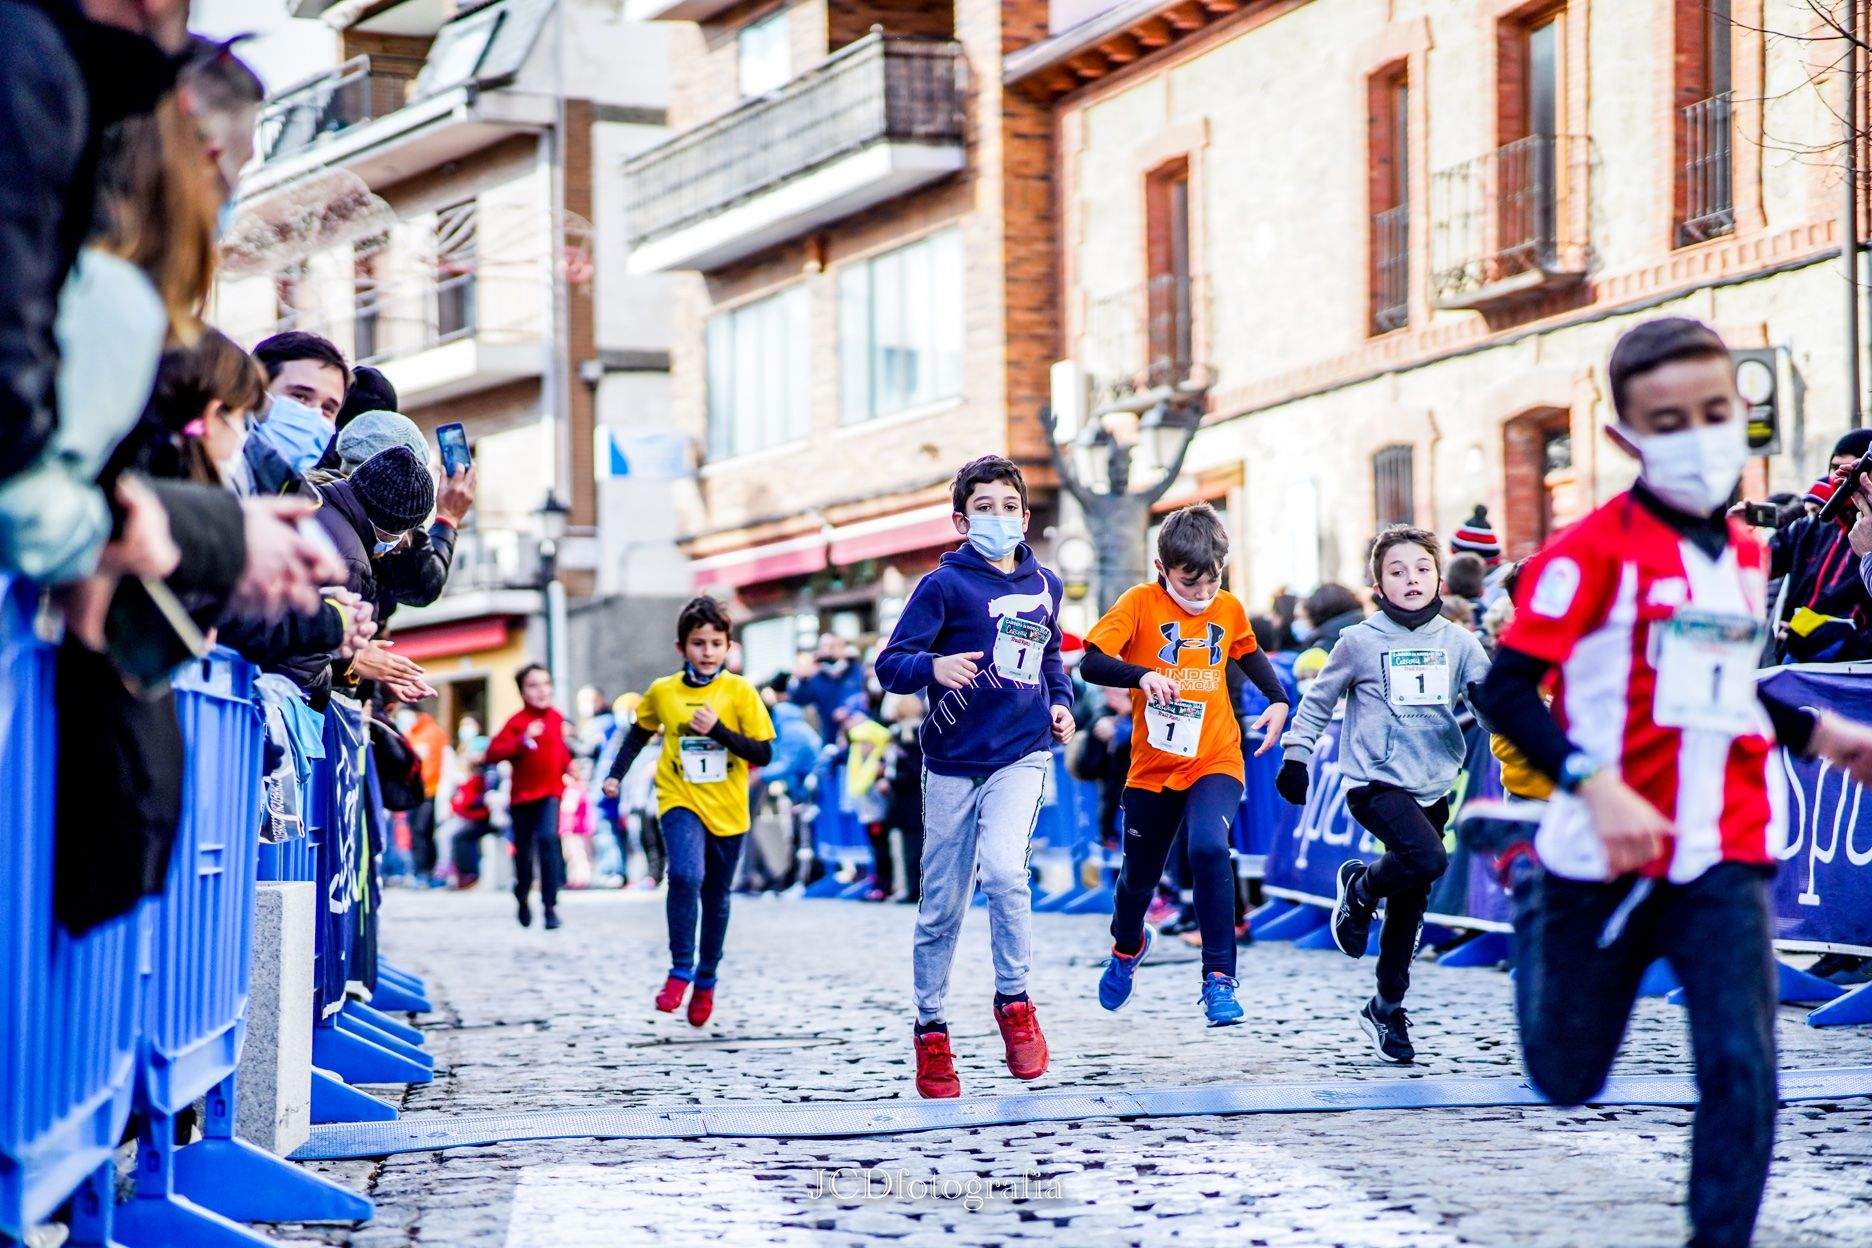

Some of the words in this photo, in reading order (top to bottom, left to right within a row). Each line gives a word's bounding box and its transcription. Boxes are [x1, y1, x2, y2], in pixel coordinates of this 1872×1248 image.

[1017, 647, 1026, 669] 1
[1415, 673, 1424, 693] 1
[1711, 663, 1722, 705] 1
[1166, 722, 1175, 741] 1
[700, 758, 706, 773] 1
